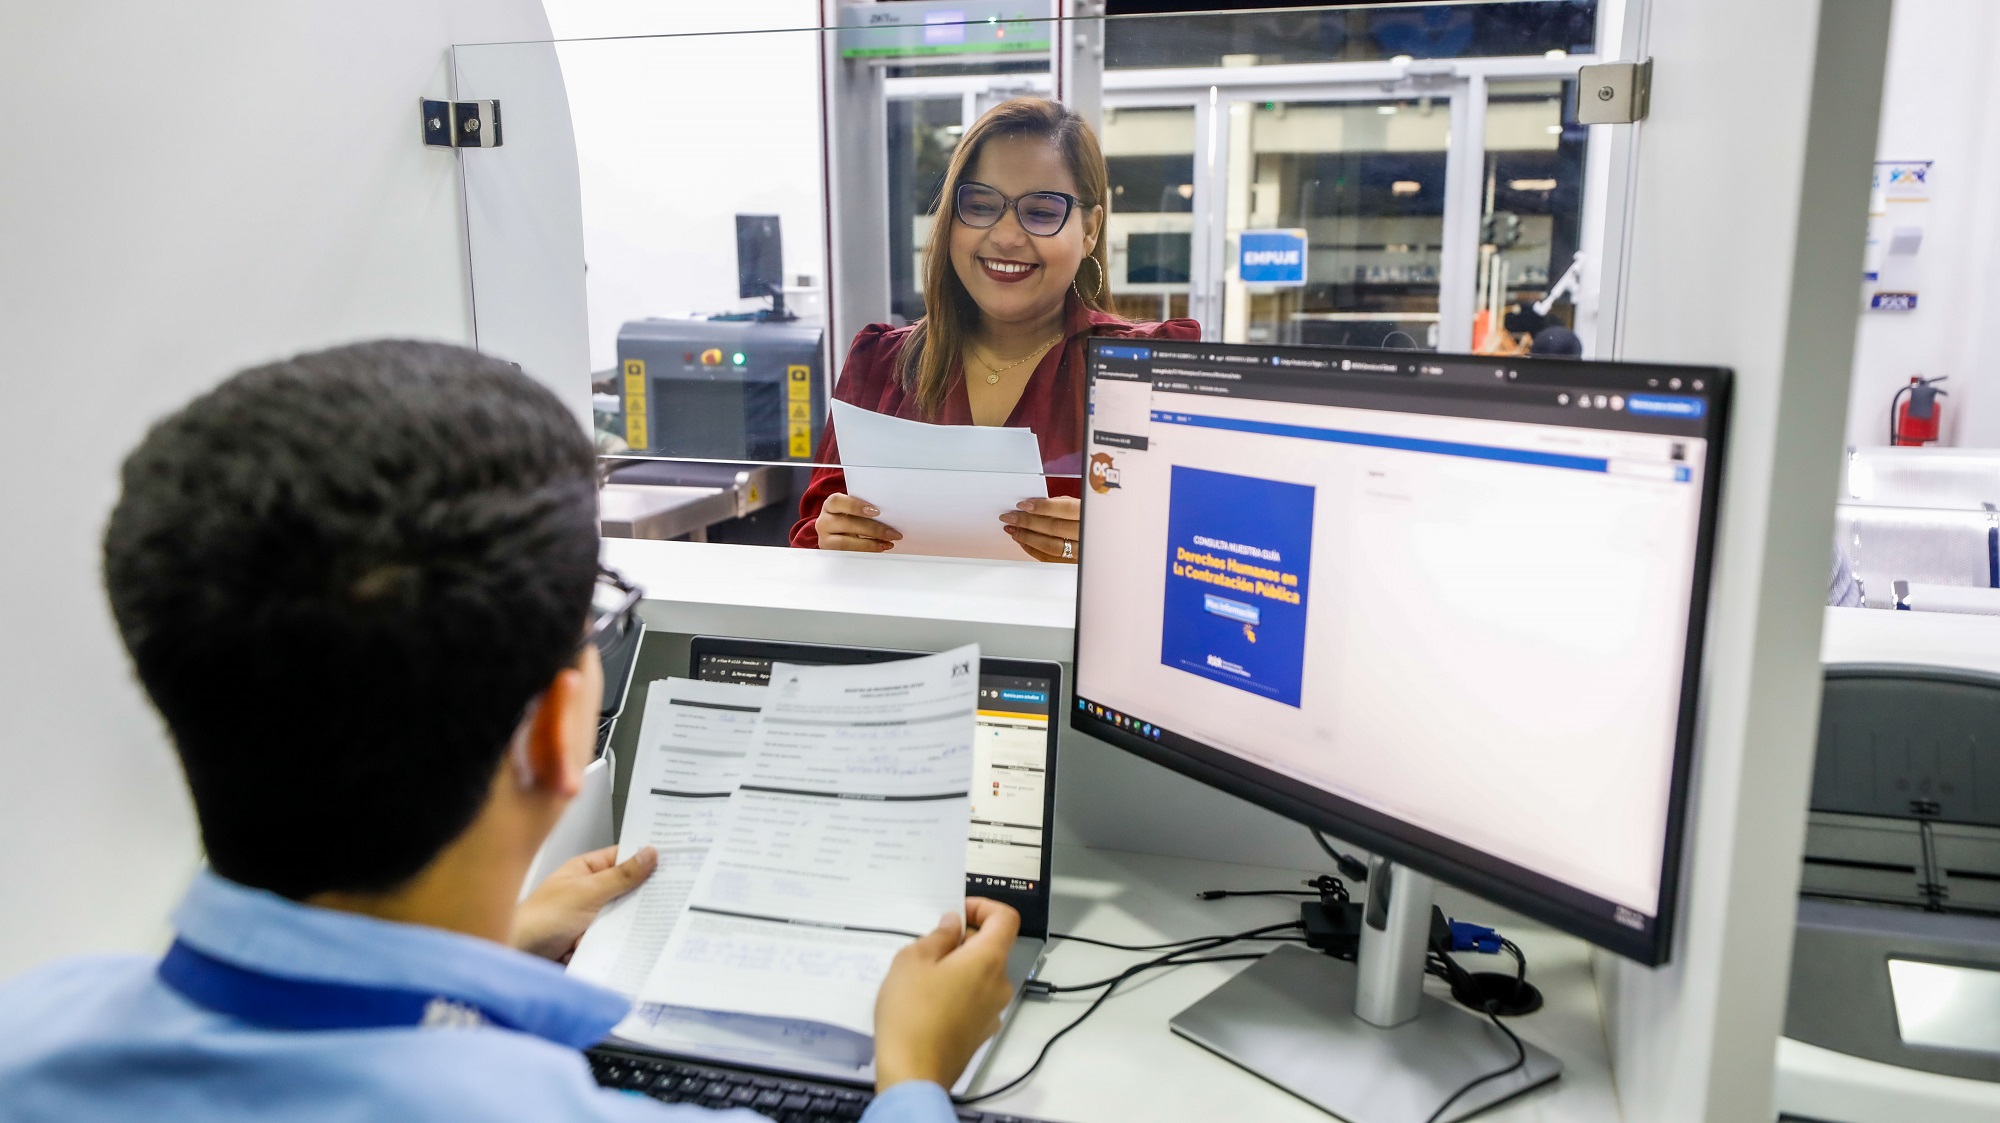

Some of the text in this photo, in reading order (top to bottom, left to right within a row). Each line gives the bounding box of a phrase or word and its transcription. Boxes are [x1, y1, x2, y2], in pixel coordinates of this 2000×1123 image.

[1244, 250, 1299, 266] EMPUJE
[1193, 535, 1228, 550] CONSULTA
[1229, 542, 1261, 558] NUESTRA
[1177, 547, 1298, 587] Derechos Humanos en
[1173, 561, 1300, 605] la Contratación Pública
